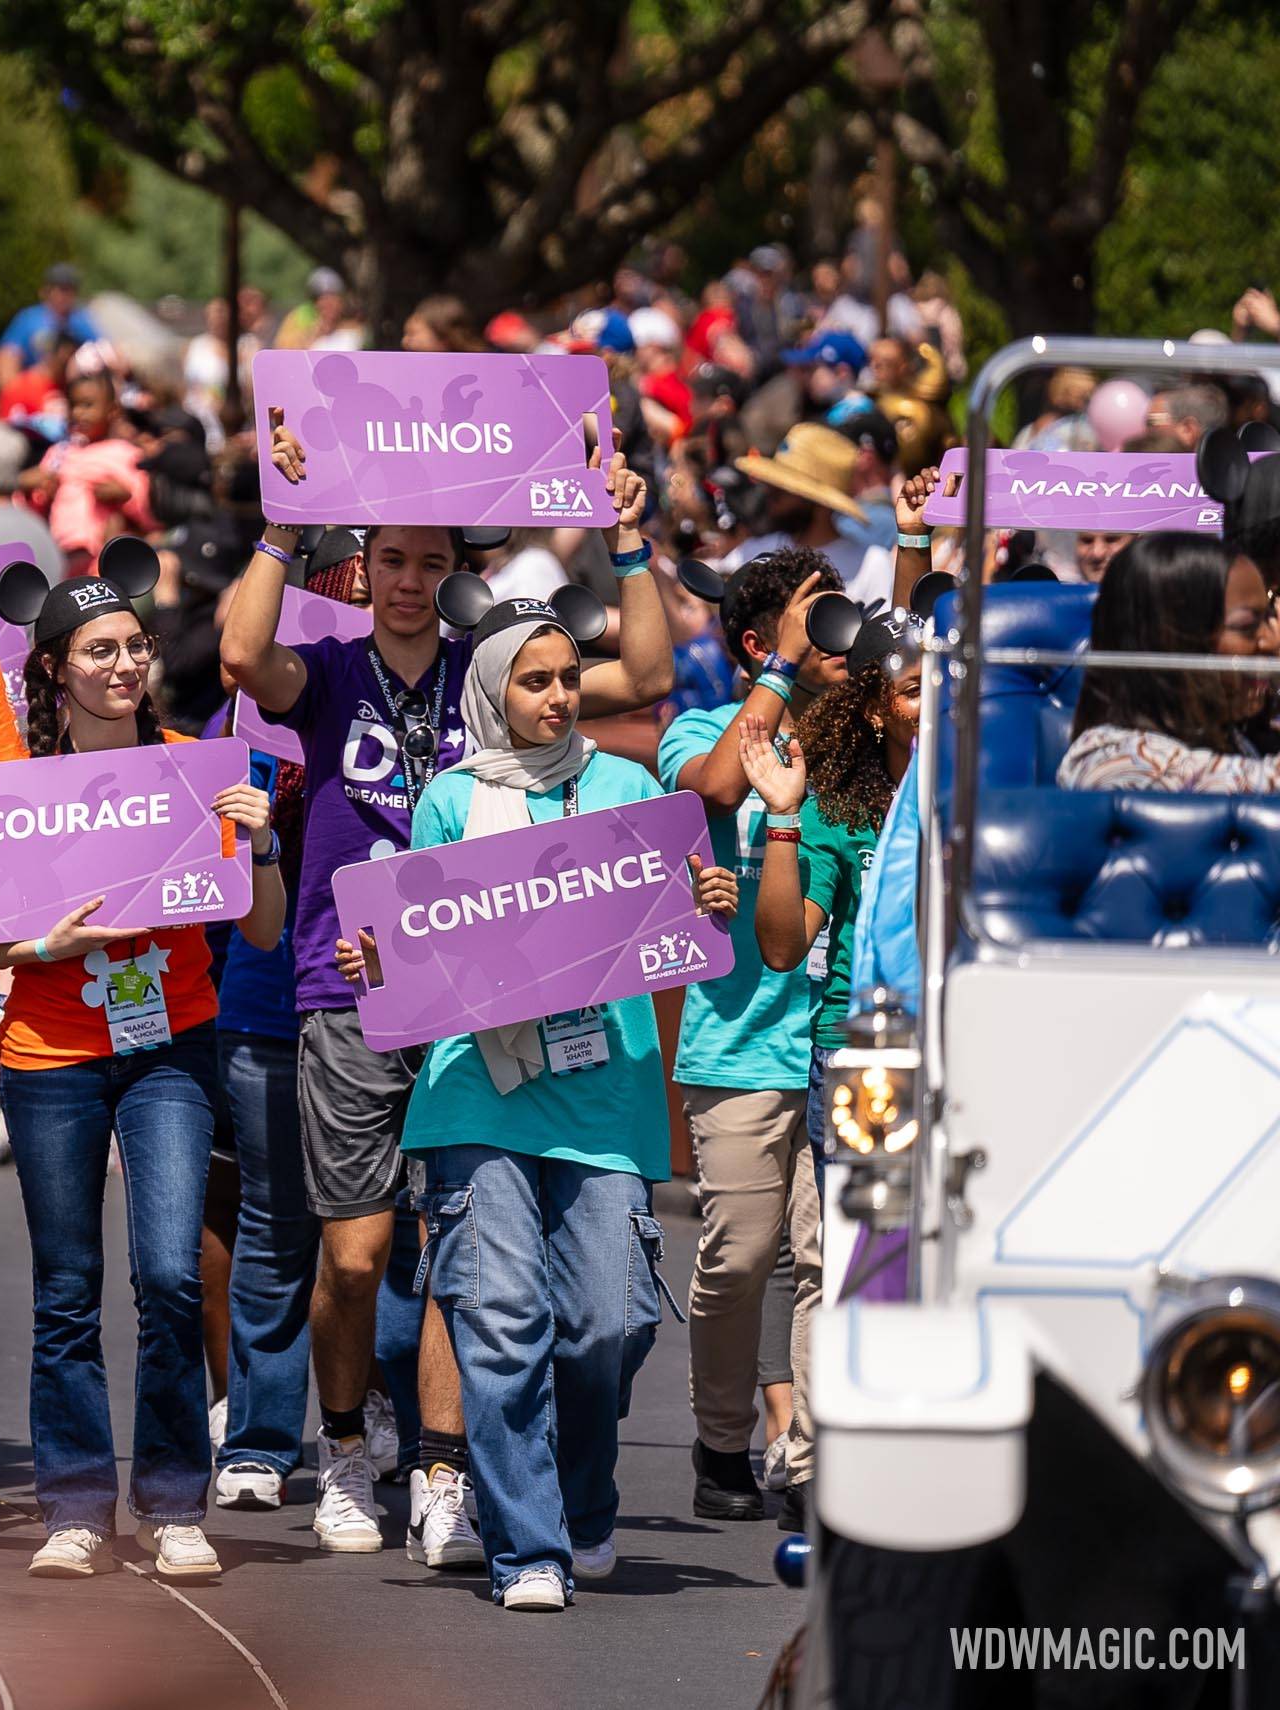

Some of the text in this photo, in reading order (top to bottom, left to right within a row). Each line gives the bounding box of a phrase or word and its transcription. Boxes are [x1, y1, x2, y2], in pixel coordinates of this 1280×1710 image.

[366, 421, 513, 455] ILLINOIS
[400, 850, 666, 938] CONFIDENCE
[124, 1020, 157, 1033] BIANCA
[563, 1041, 592, 1054] ZAHRA
[566, 1050, 593, 1061] KHATRI
